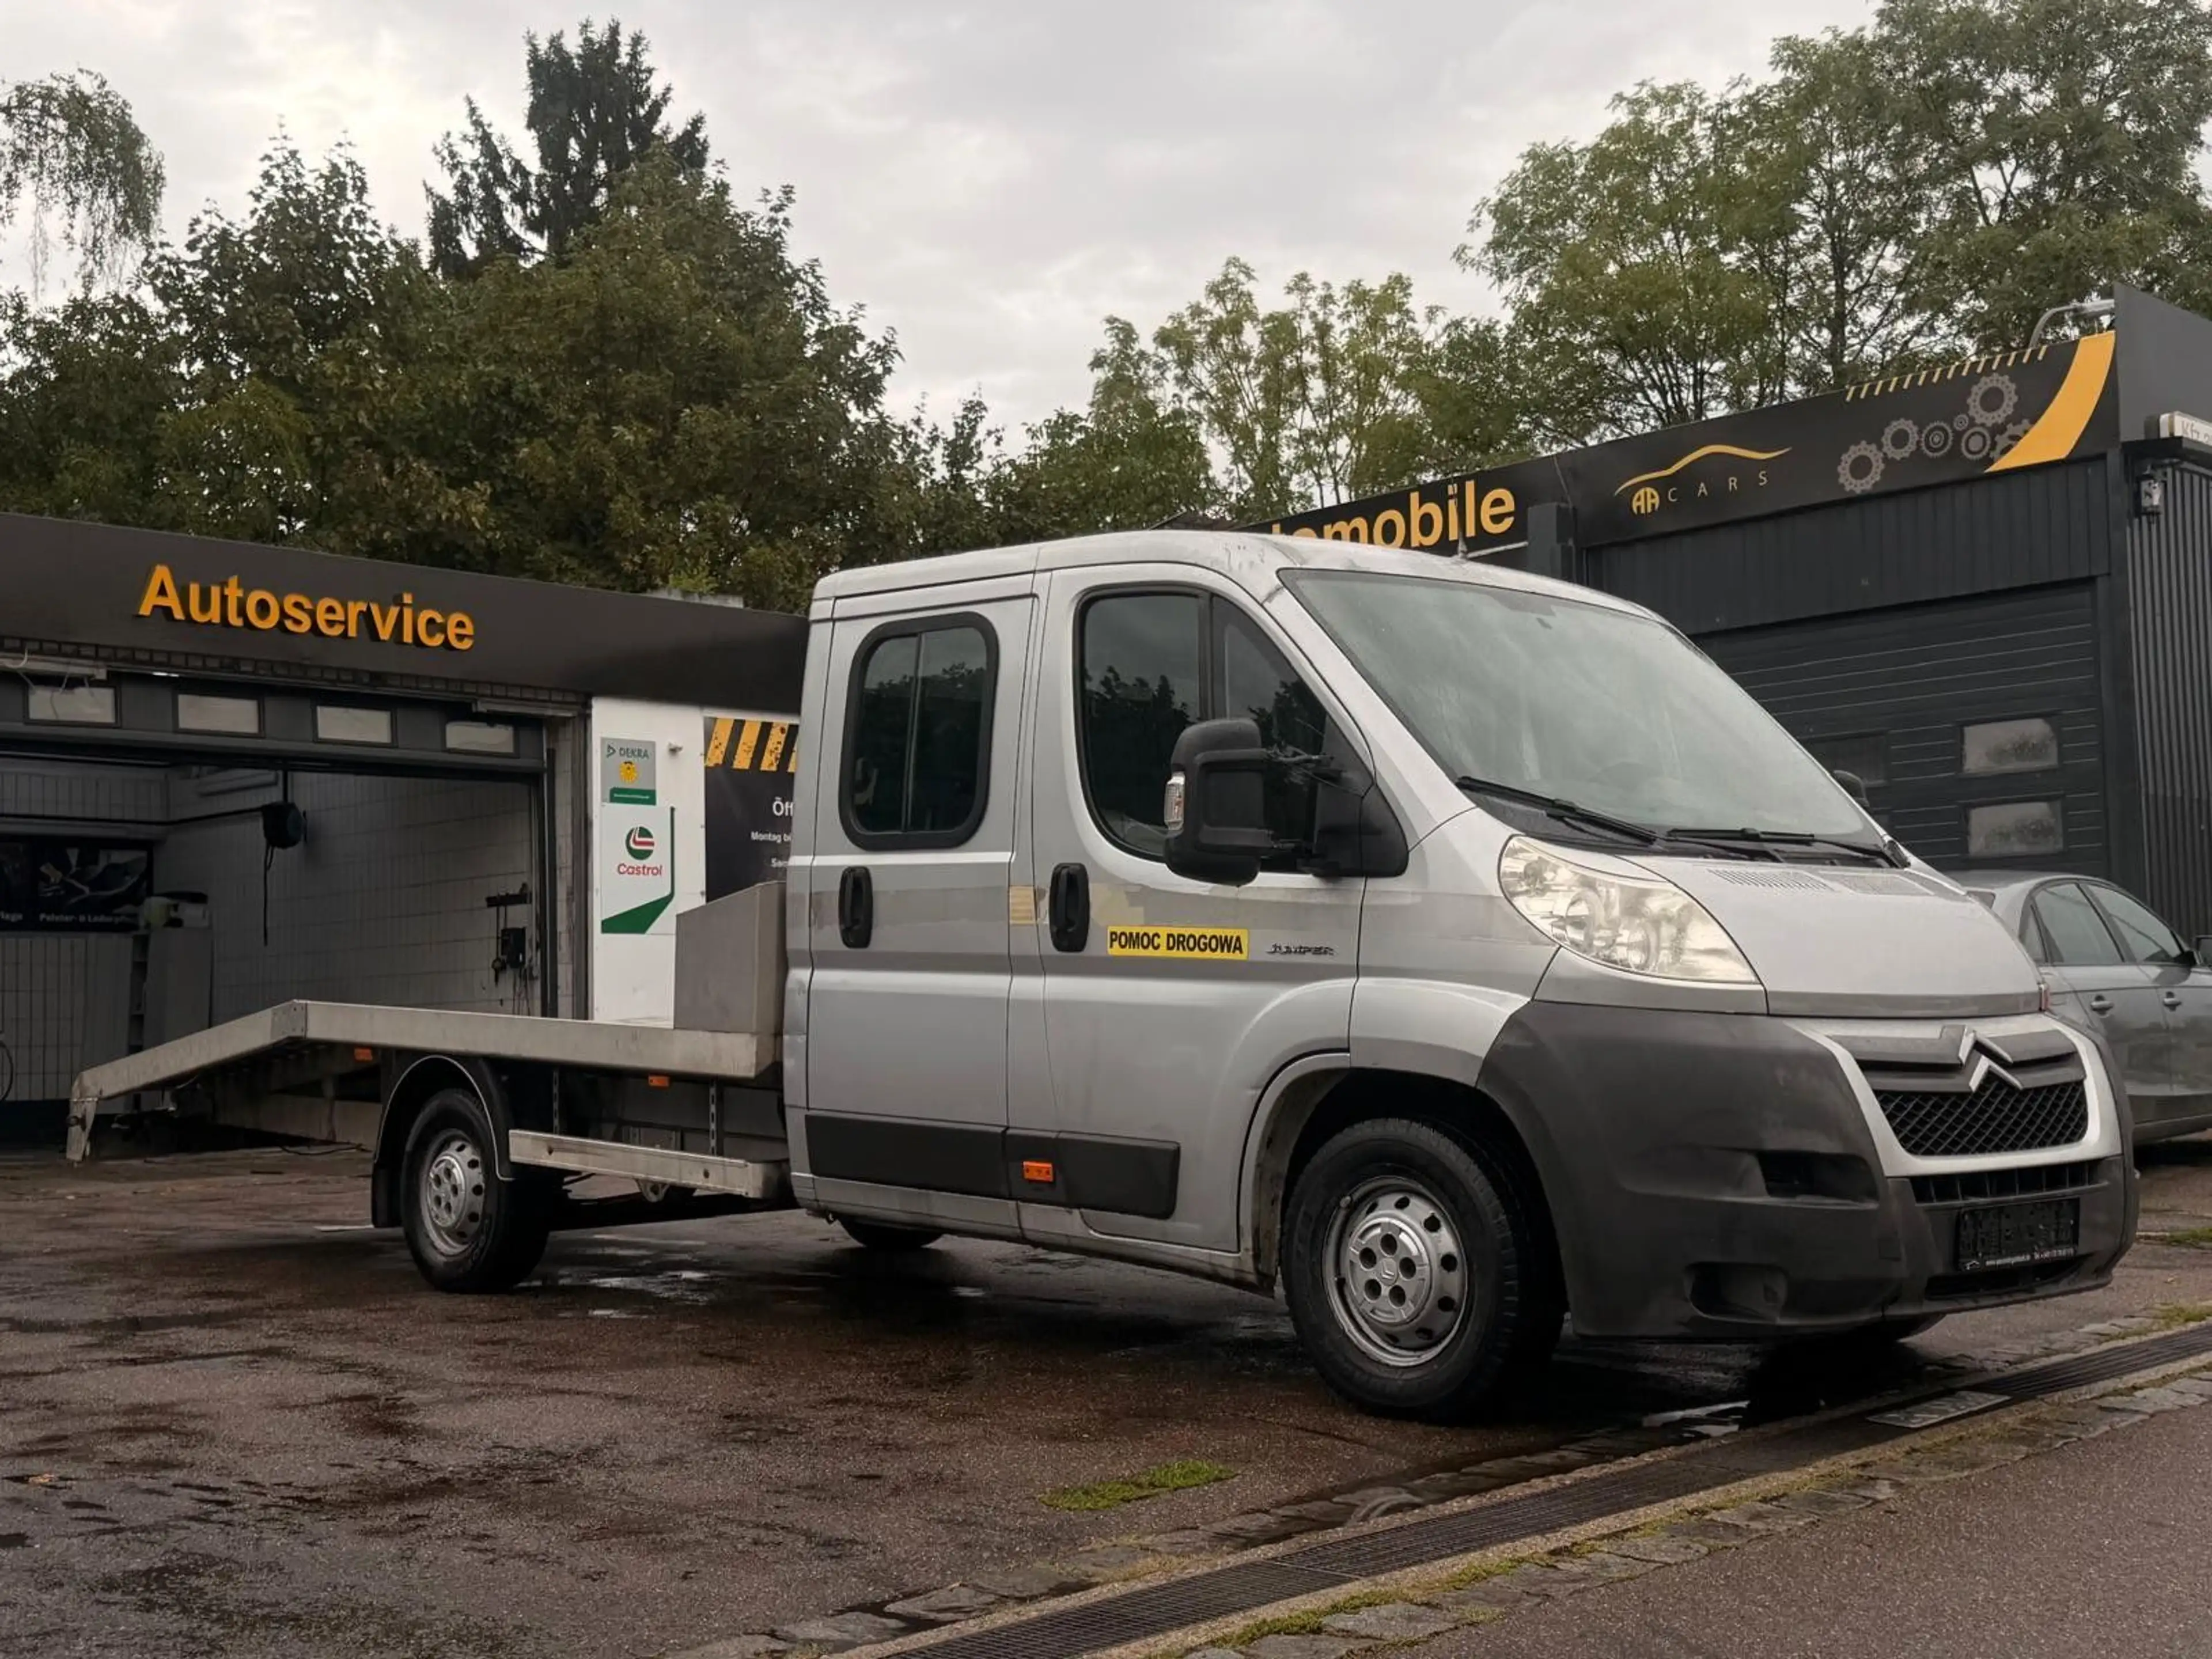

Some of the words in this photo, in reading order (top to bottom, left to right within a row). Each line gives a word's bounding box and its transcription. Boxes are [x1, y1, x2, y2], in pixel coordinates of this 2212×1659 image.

[1667, 470, 1768, 502] CARS
[1272, 480, 1516, 549] mobile
[138, 563, 475, 650] Autoservice
[619, 747, 650, 759] DEKRA
[751, 831, 782, 844] Montag
[618, 863, 662, 876] Castrol
[1109, 931, 1161, 950] POMOC
[1166, 933, 1243, 954] DROGOWA
